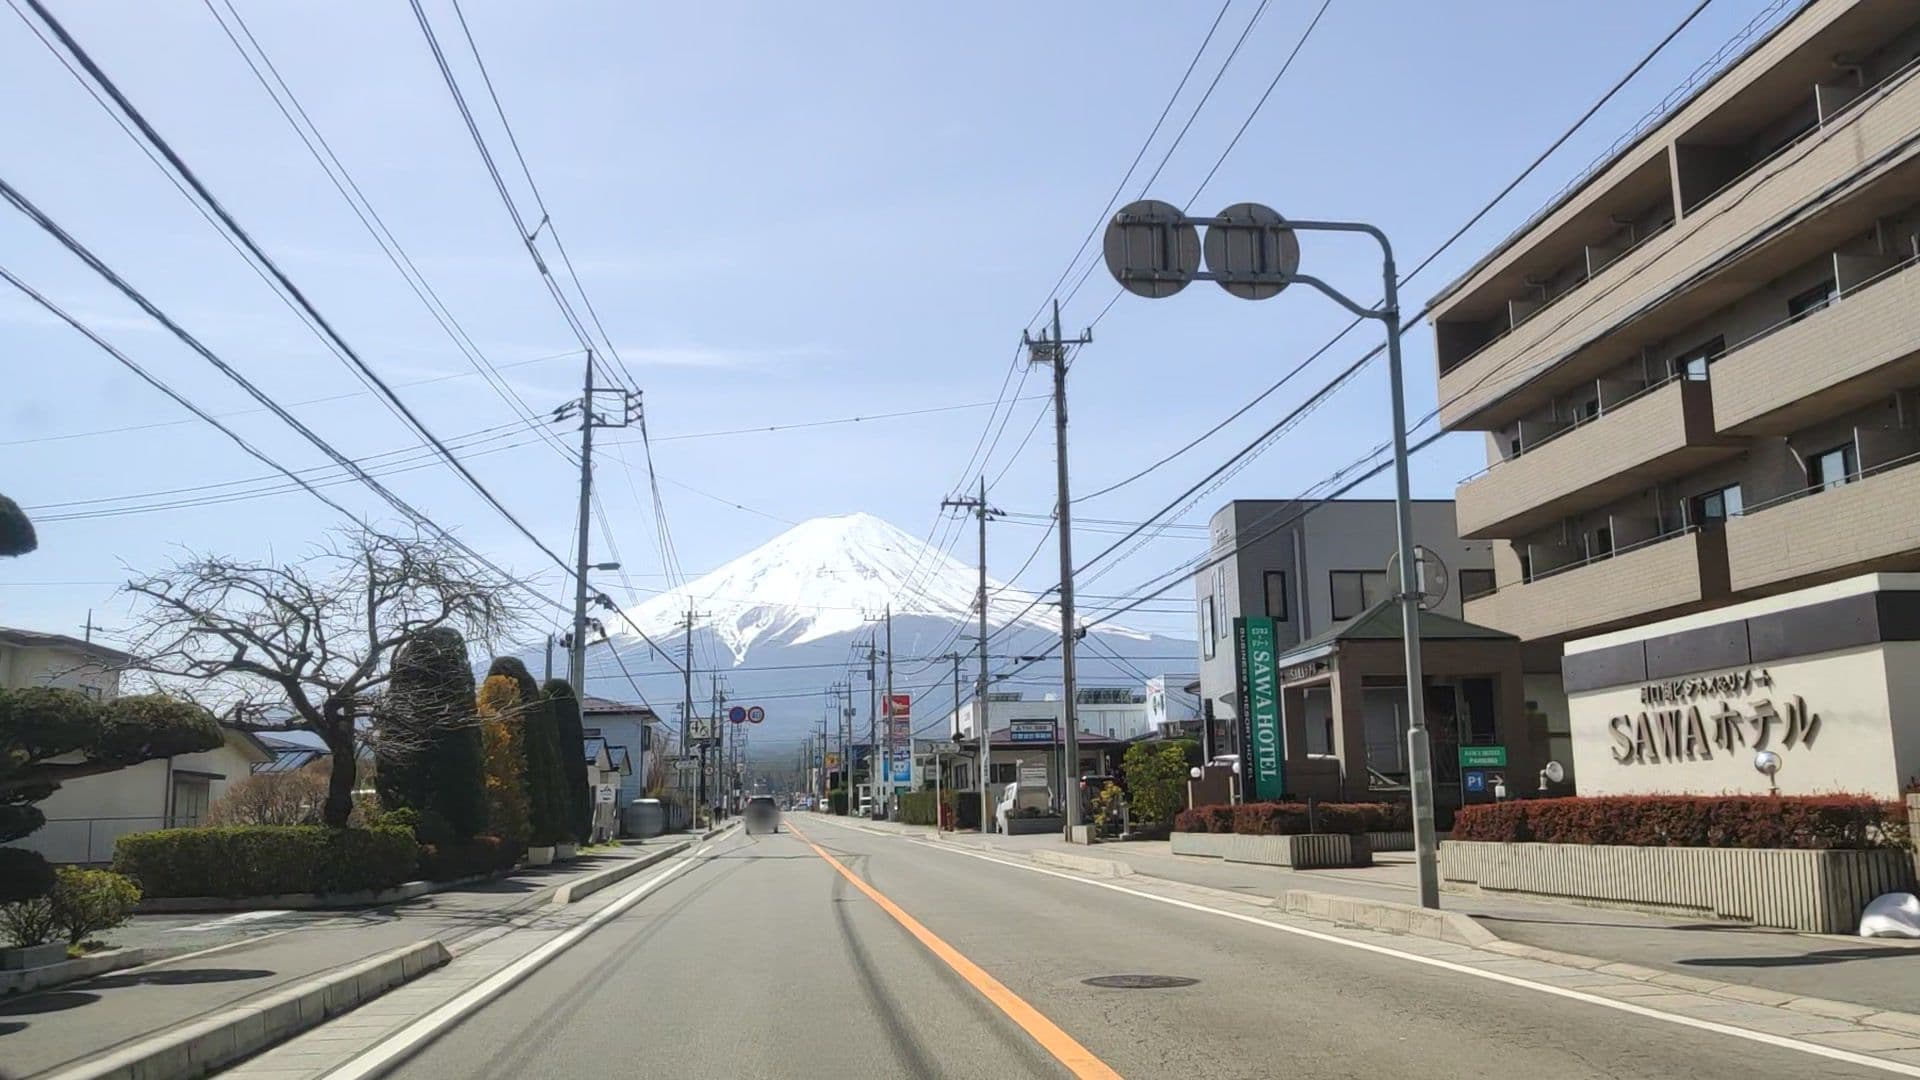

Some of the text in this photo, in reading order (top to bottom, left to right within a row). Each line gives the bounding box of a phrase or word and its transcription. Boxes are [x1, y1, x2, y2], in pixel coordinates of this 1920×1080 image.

[1253, 650, 1277, 782] SAWA HOTEL
[1608, 694, 1822, 763] SAWAホテル
[1246, 744, 1254, 779] HOTEL
[1468, 776, 1481, 787] P1
